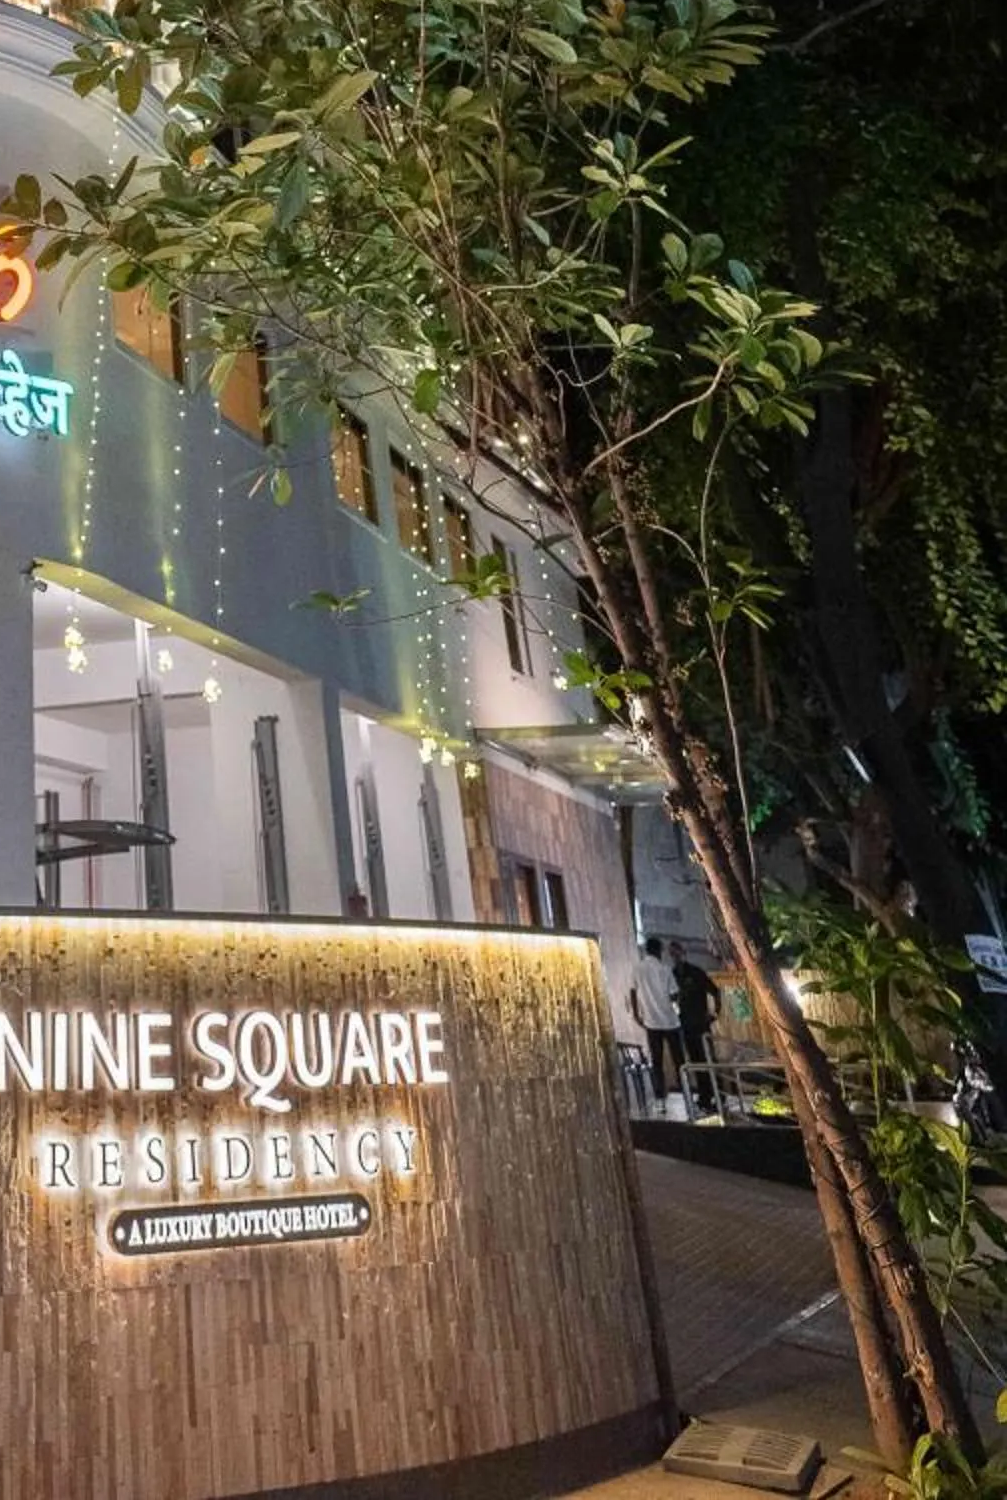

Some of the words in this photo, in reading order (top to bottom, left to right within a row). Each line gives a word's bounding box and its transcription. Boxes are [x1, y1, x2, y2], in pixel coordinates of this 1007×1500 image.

[194, 1011, 449, 1112] SQUARE
[46, 1129, 416, 1188] RESIDENCY
[128, 1219, 144, 1246] A
[145, 1213, 216, 1245] LUXURY
[216, 1208, 302, 1238] BOUTIQUE
[302, 1203, 358, 1230] HOTEL
